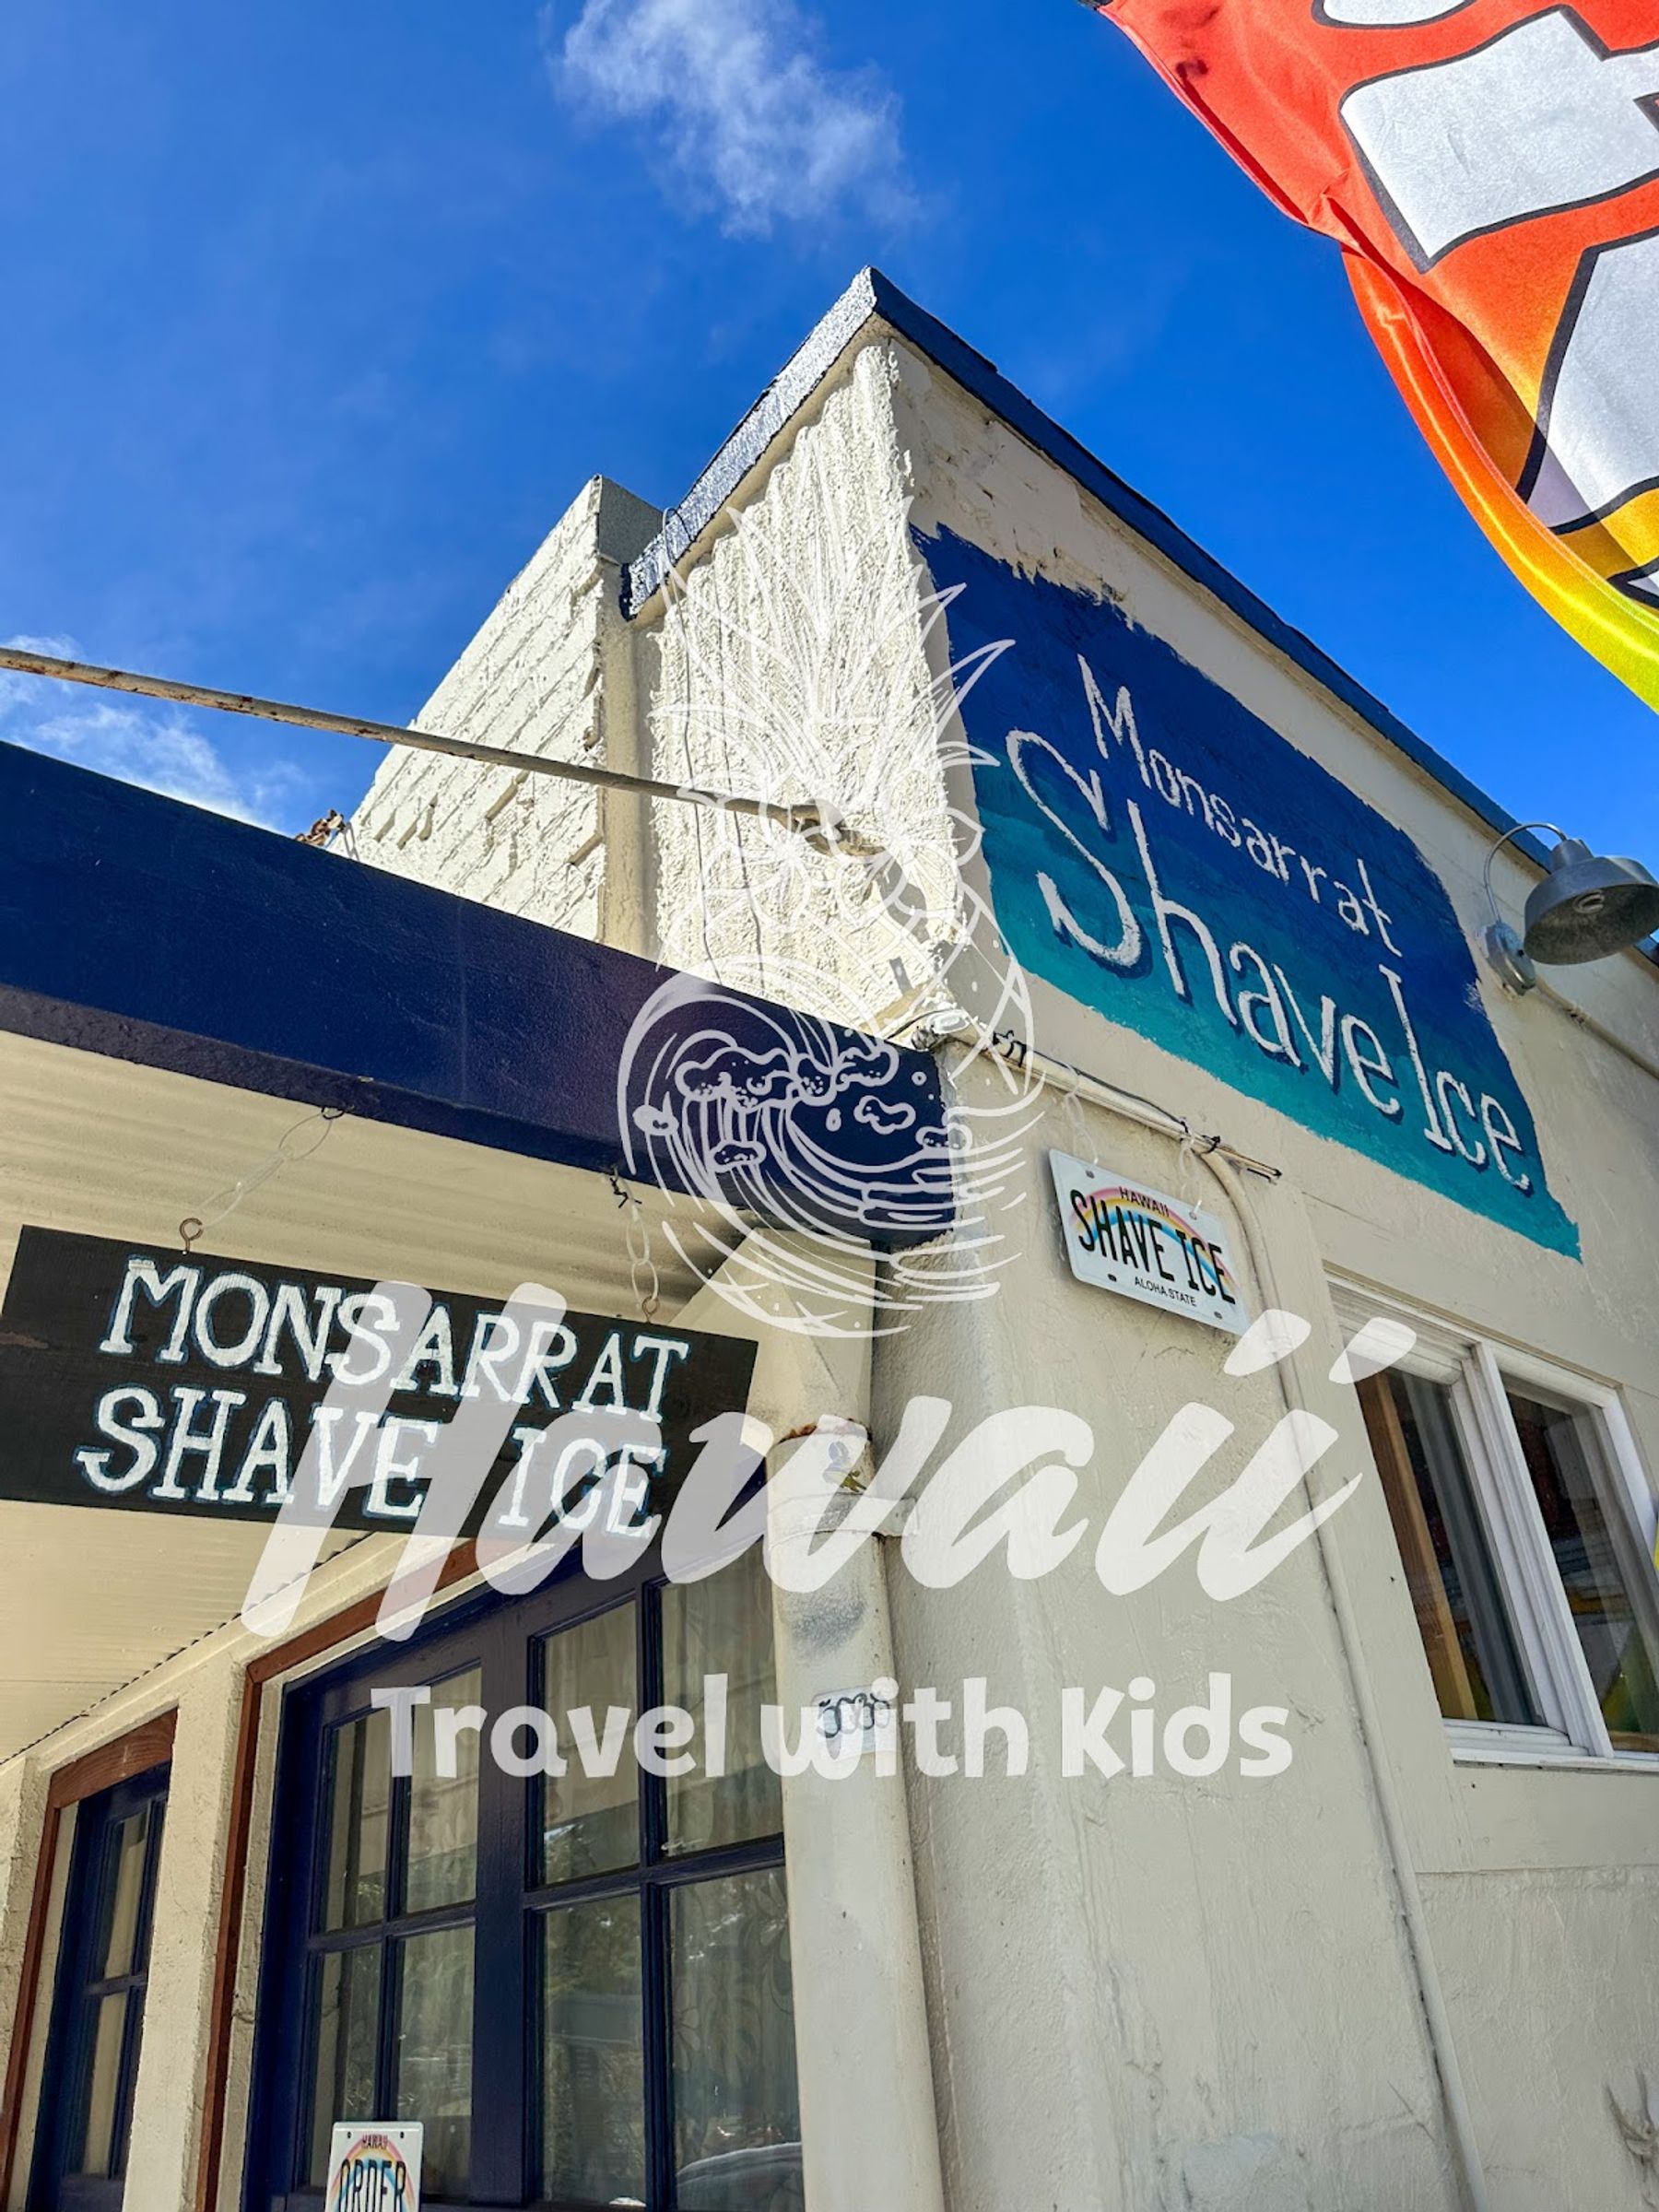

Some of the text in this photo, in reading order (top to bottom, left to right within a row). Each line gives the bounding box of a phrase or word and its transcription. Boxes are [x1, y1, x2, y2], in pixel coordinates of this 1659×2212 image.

[1077, 653, 1402, 958] Monsarrat
[1006, 728, 1530, 1191] Shave Ice
[1070, 1189, 1236, 1305] SHAVE ICE
[1119, 1186, 1171, 1217] HAWAII
[100, 1258, 689, 1424] MONSARRAT
[1135, 1277, 1197, 1307] ALOHA STATE
[75, 1385, 665, 1538] SHAVE ICE
[339, 2158, 406, 2212] ORDER
